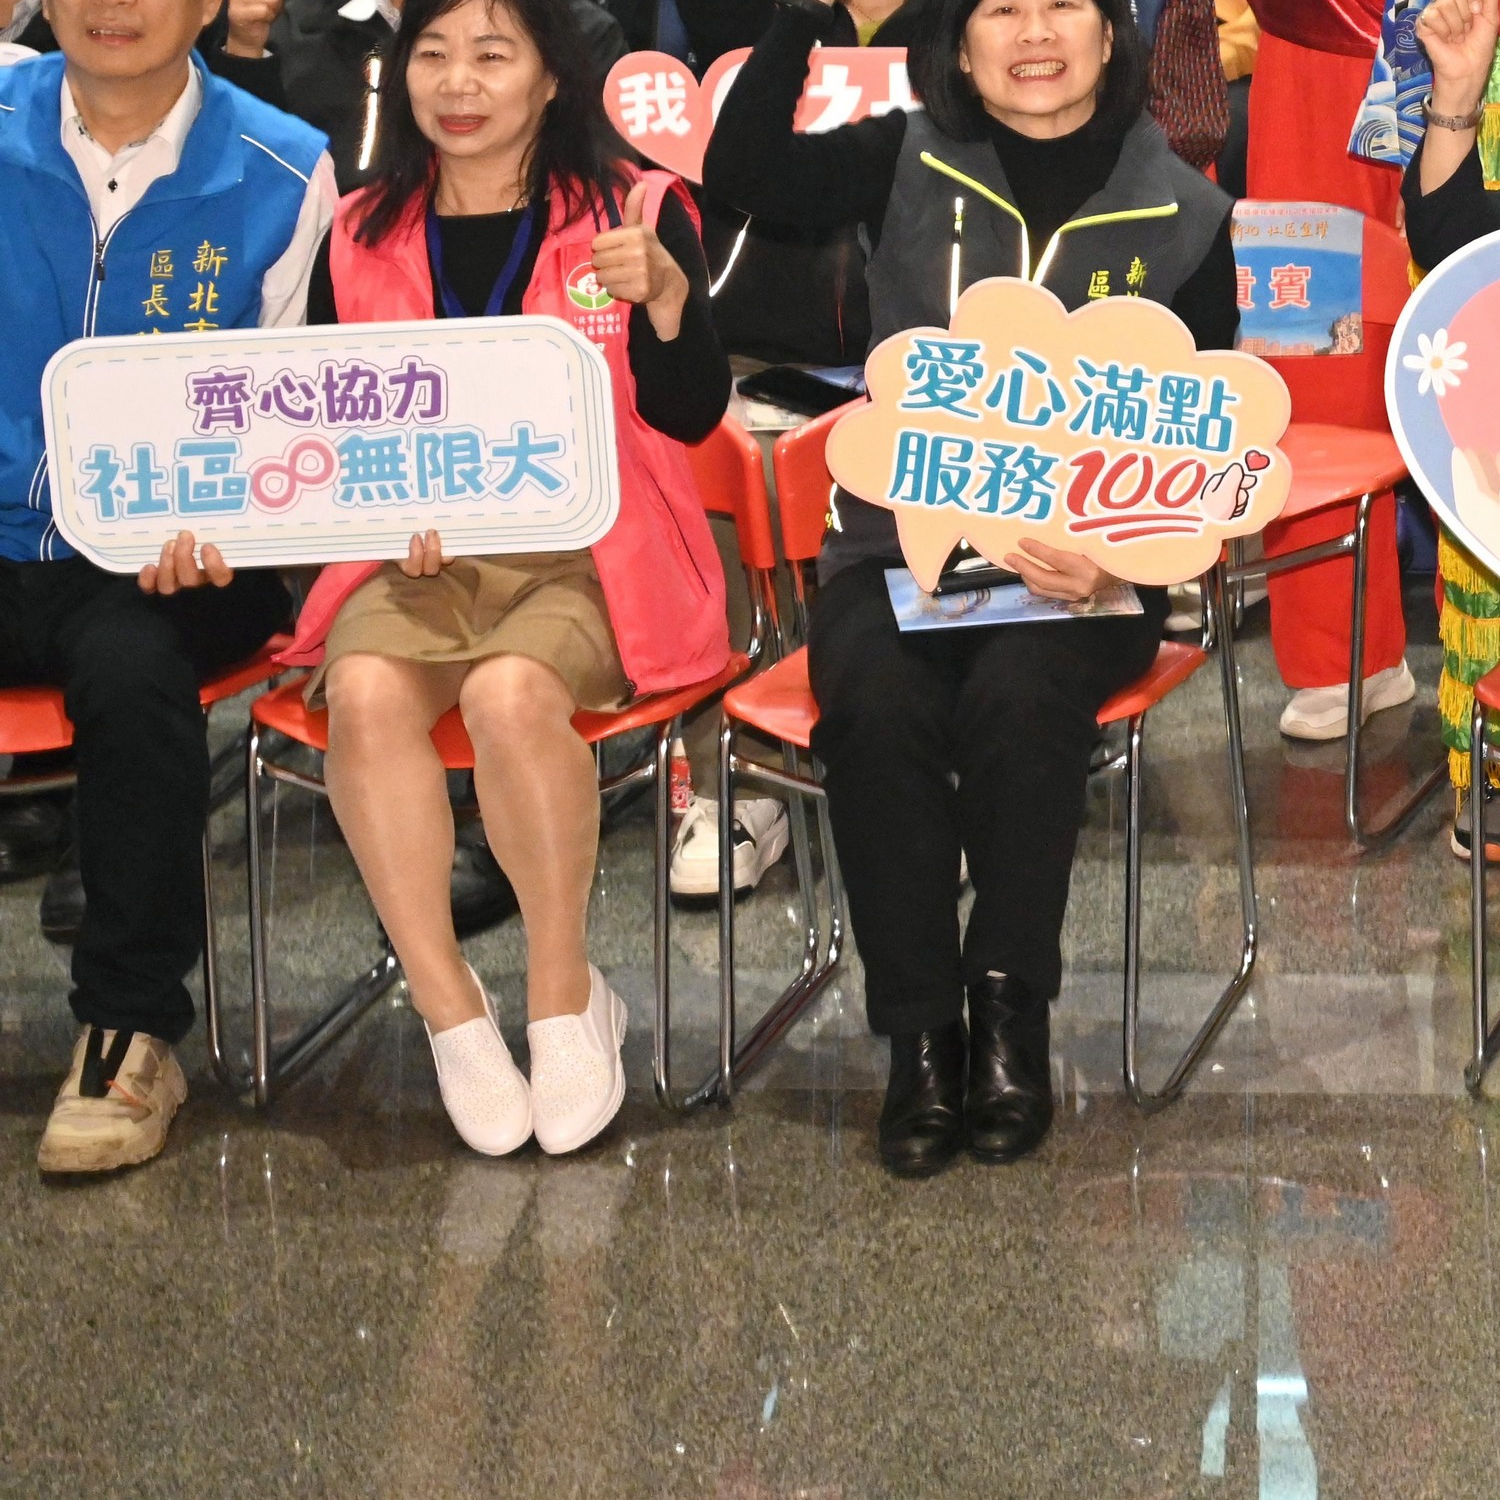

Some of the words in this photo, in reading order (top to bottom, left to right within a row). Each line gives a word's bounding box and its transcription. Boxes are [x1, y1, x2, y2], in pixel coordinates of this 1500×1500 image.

[618, 71, 692, 137] 我
[136, 249, 173, 335] 區長
[192, 360, 449, 430] 齊心協力
[900, 338, 1239, 453] 愛心滿點
